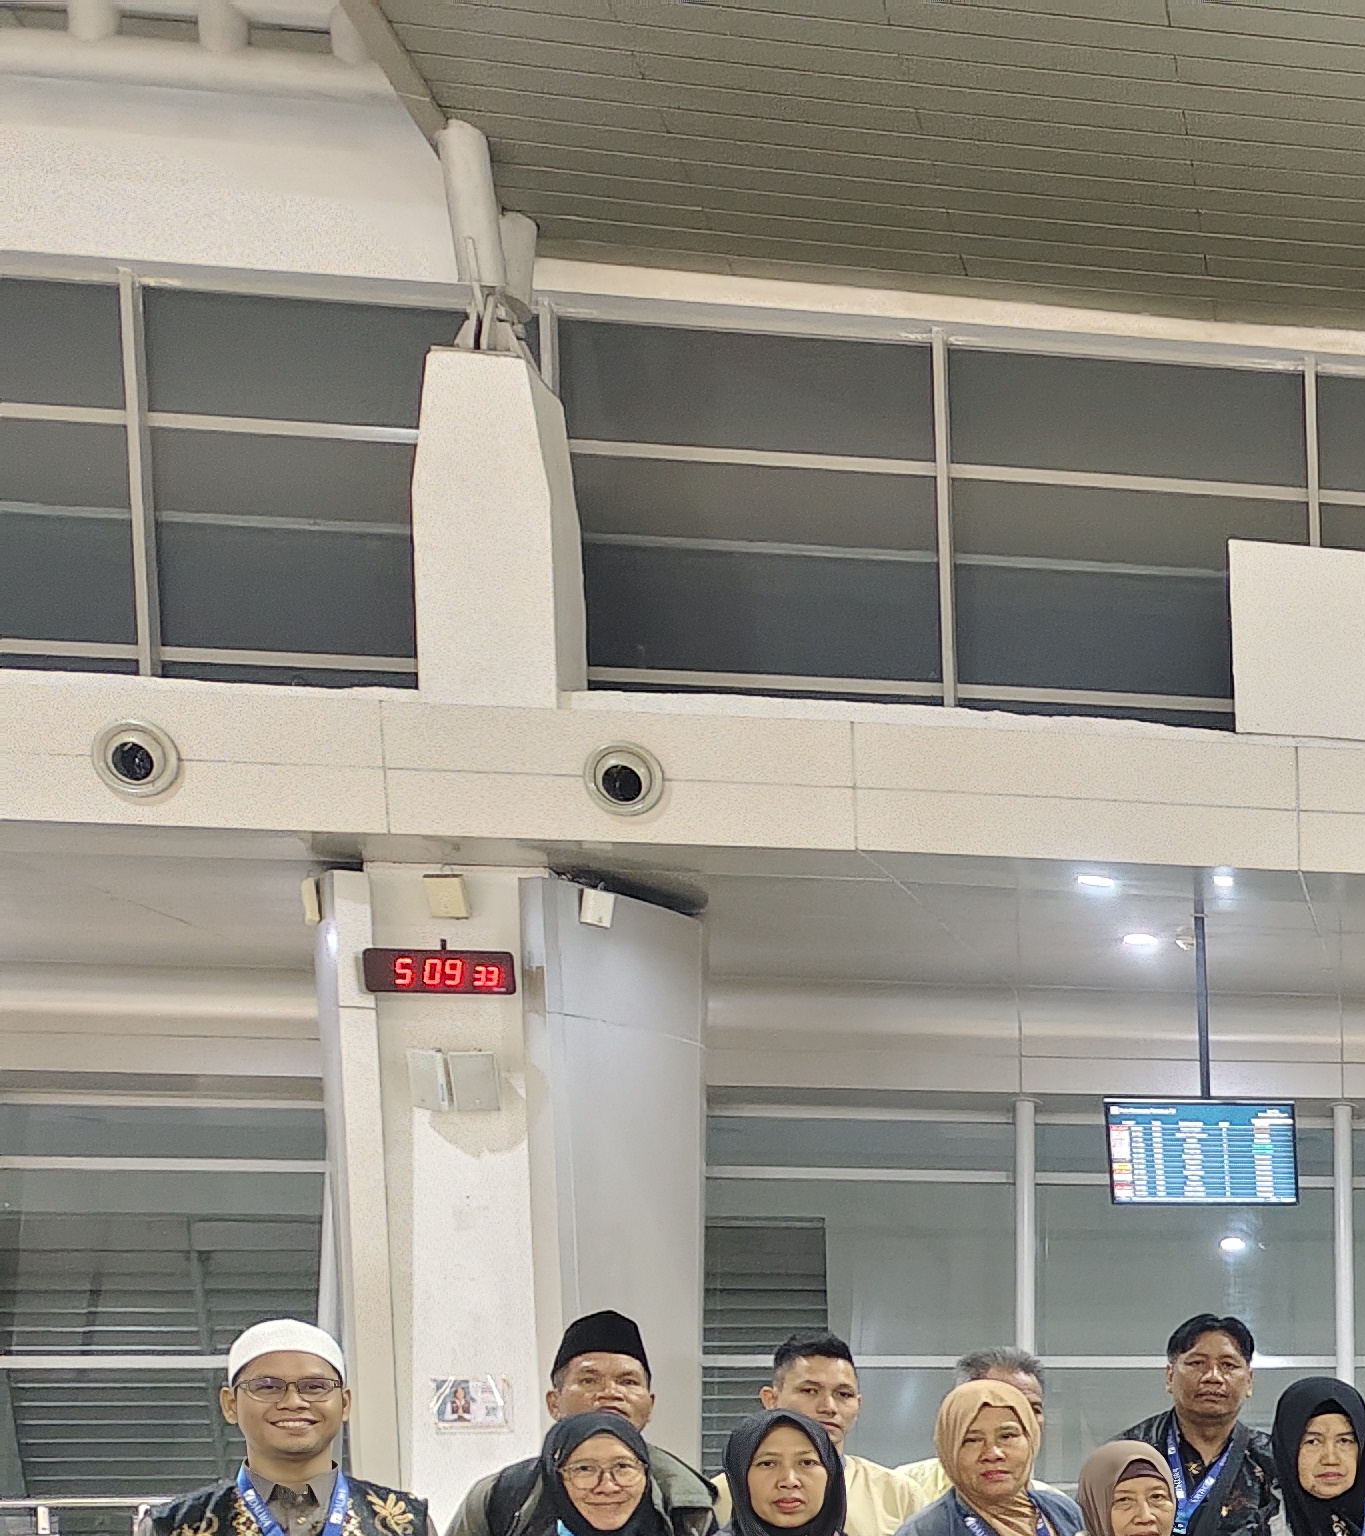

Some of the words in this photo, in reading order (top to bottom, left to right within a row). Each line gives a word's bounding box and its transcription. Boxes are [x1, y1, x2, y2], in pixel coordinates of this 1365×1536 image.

[394, 956, 414, 986] 5
[422, 957, 463, 986] 09
[473, 965, 500, 987] 33
[247, 1498, 272, 1526] DALWA
